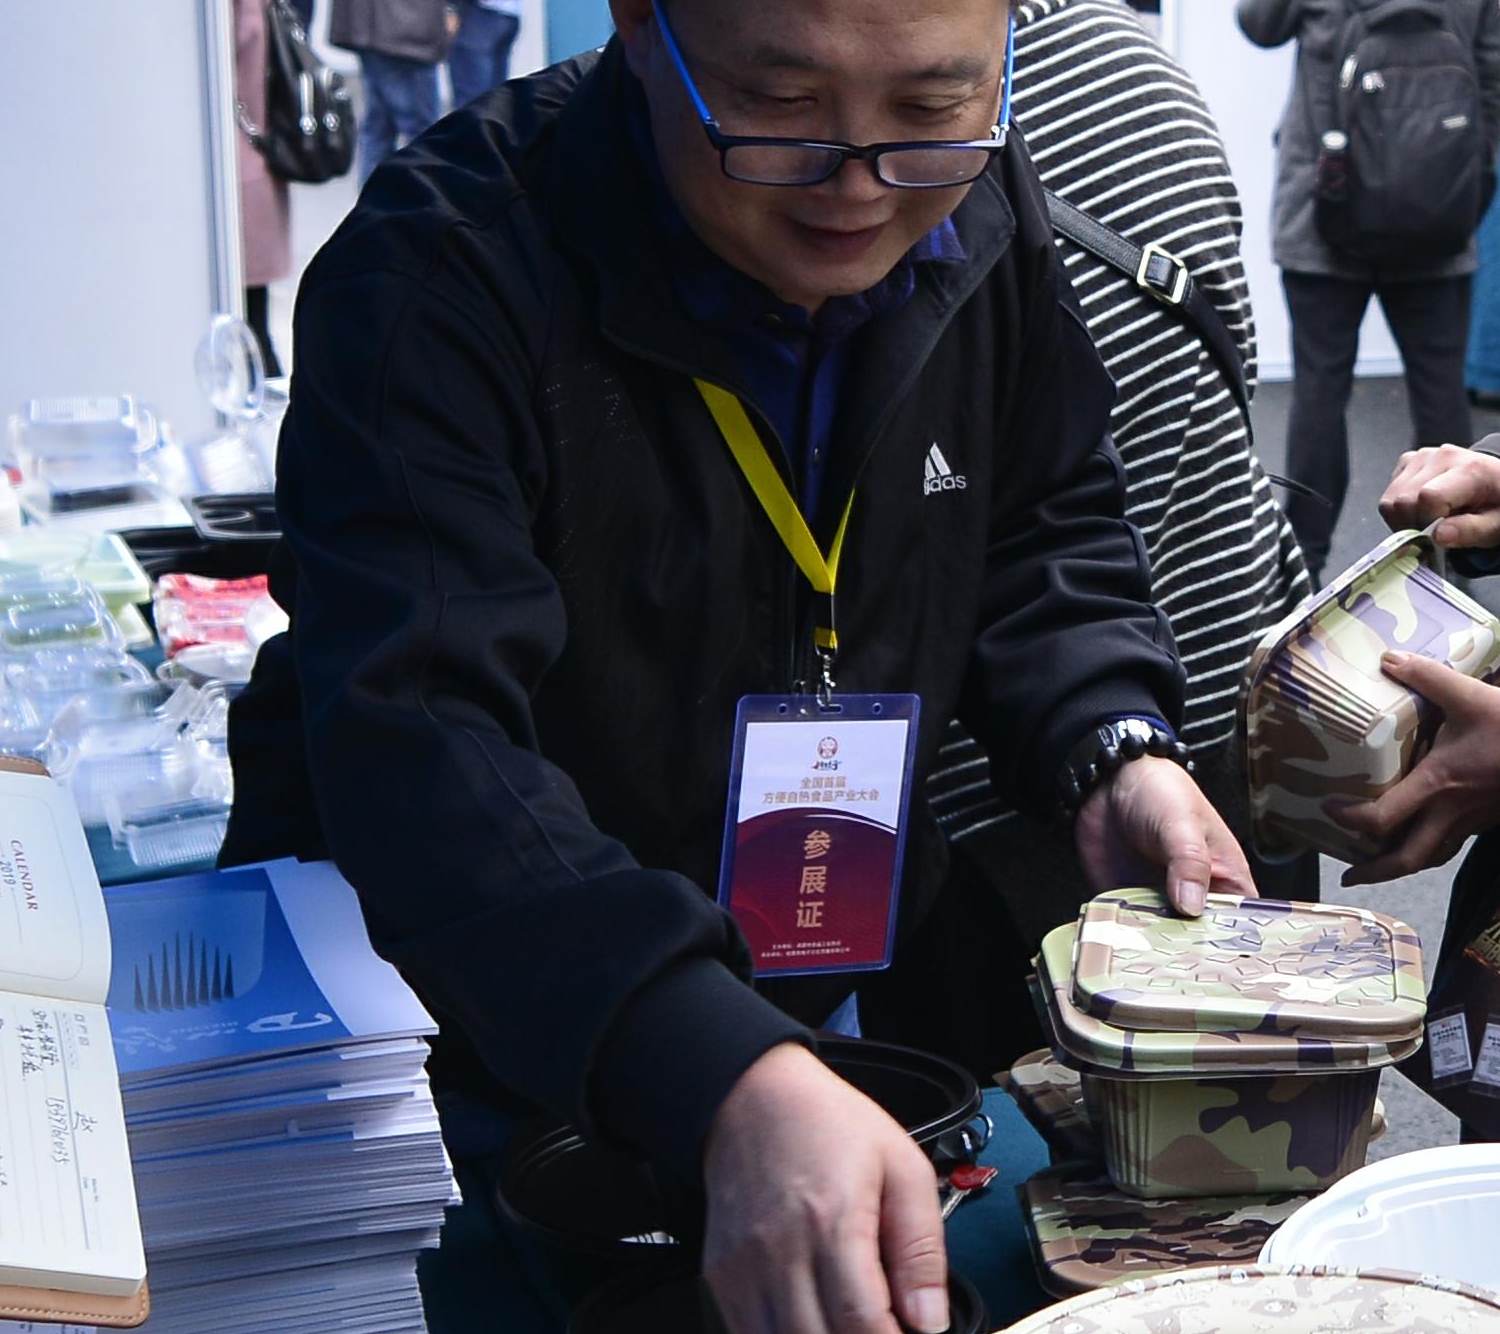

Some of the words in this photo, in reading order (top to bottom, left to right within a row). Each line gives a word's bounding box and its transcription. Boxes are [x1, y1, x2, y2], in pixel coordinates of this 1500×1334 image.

[762, 788, 881, 804] 方便自热食品产业大会
[800, 776, 847, 789] 全国首届
[8, 837, 40, 913] CALENDAR
[795, 829, 832, 929] 参展证
